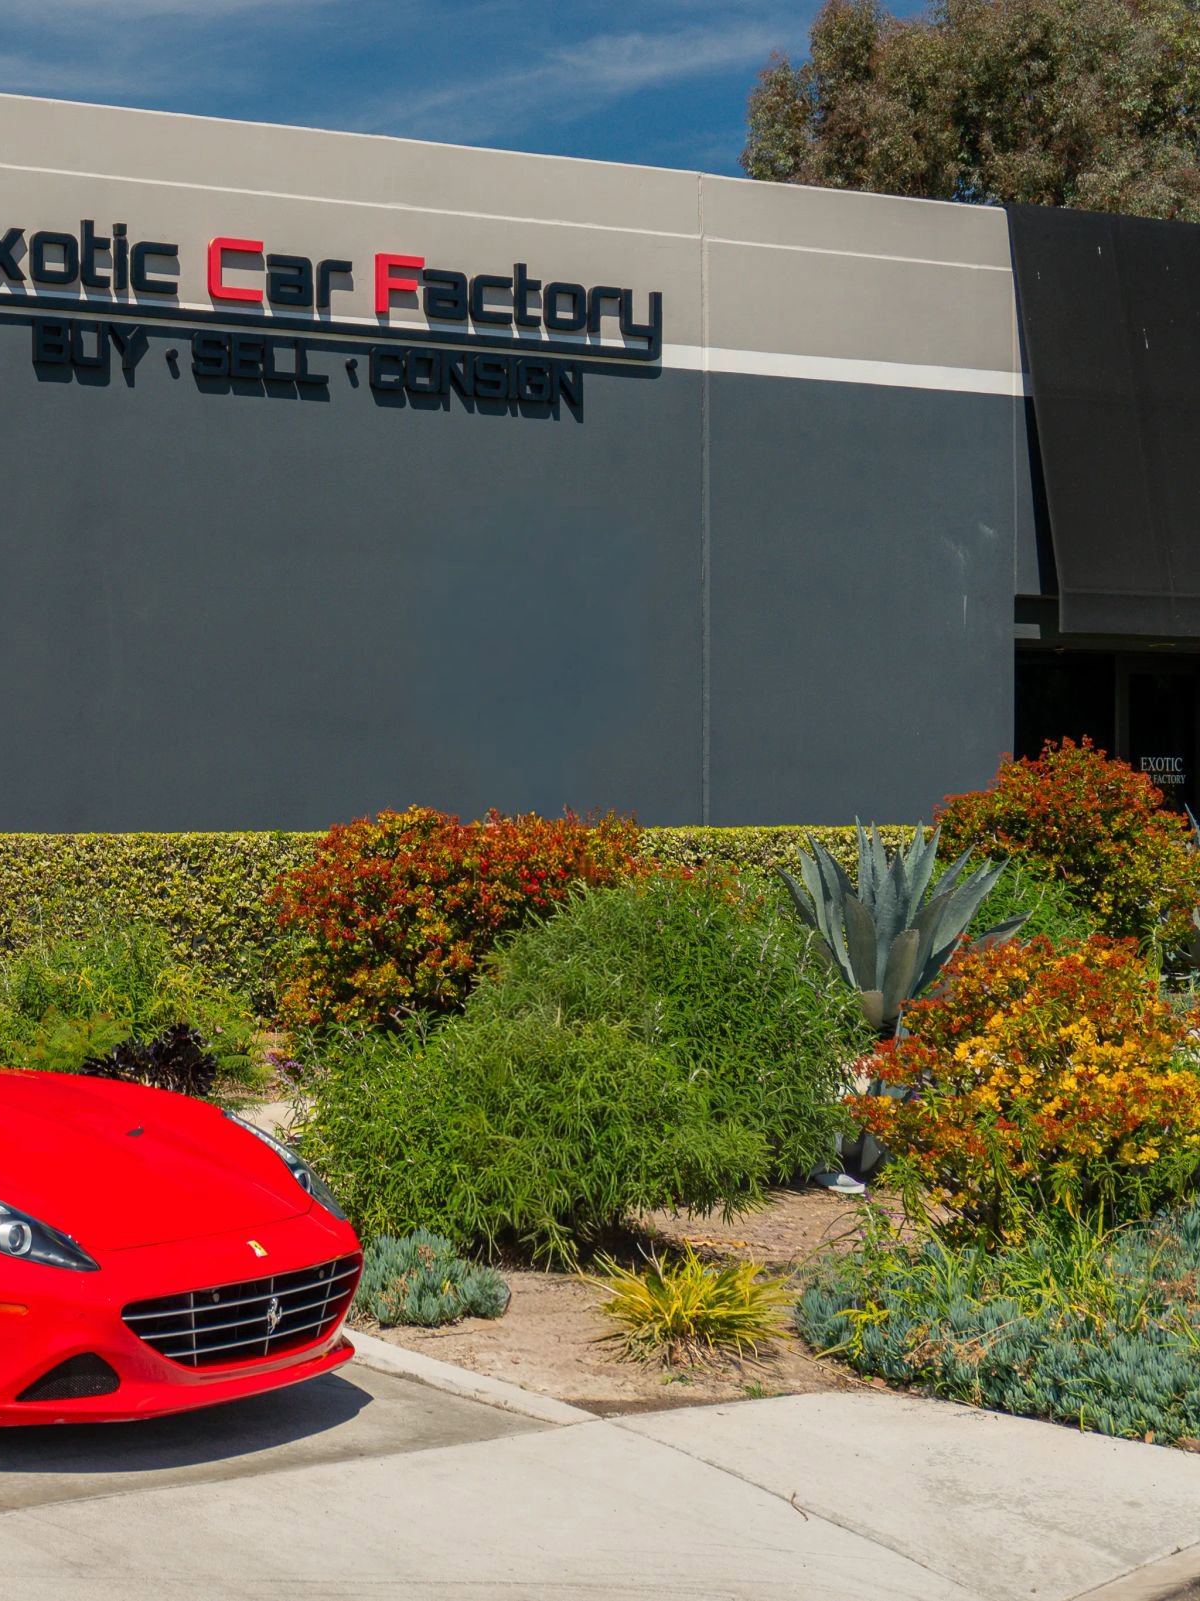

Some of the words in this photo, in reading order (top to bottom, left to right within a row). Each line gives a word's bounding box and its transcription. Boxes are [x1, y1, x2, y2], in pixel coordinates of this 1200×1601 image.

[207, 237, 353, 307] Car
[375, 253, 662, 361] Factory
[32, 319, 147, 369] BUY
[192, 331, 329, 384] SELL
[368, 346, 582, 406] CONSIGN
[1141, 757, 1183, 771] EXOTIC
[1153, 774, 1186, 784] FACTORY
